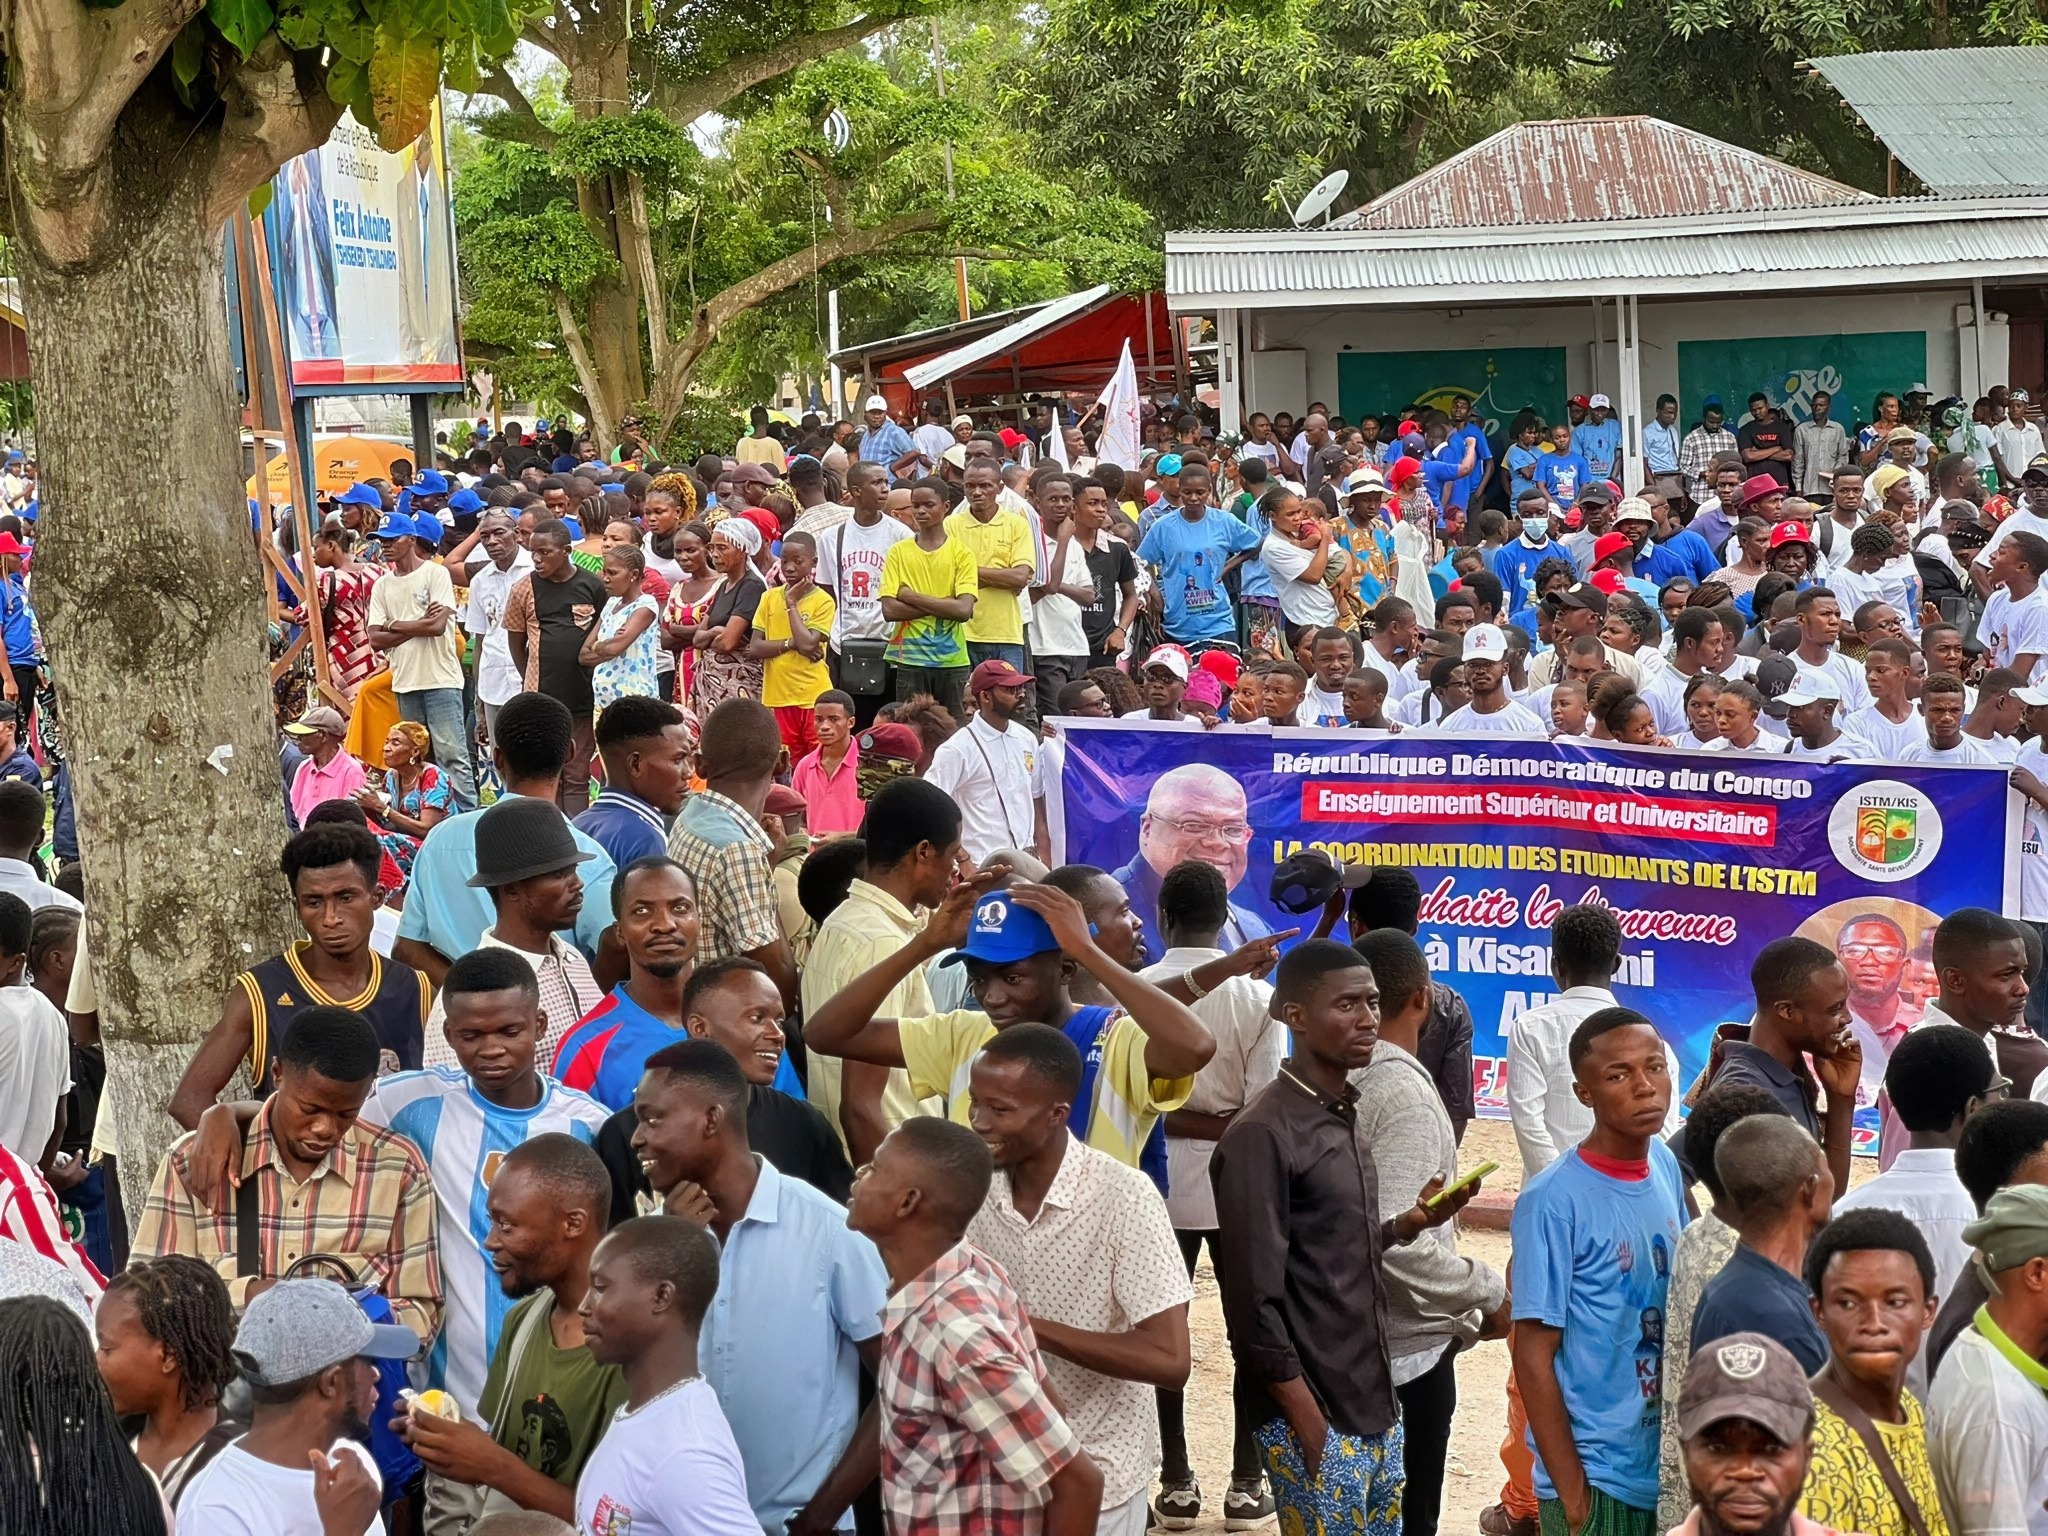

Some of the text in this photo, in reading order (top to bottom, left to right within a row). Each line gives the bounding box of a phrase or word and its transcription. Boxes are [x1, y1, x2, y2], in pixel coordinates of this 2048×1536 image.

[349, 154, 379, 187] République
[333, 199, 392, 244] Félix Antoine
[851, 571, 870, 597] R
[1273, 752, 1812, 799] République Démocratique du Congo
[1318, 789, 1769, 836] Enseignement Supérieur et Universitaire
[1859, 795, 1918, 808] ISTM/KIS
[1508, 845, 1557, 871] DES
[1560, 848, 1690, 887] ETUDIANTS
[1693, 861, 1727, 889] DE
[1525, 884, 1565, 929] la
[1423, 933, 1449, 972] à
